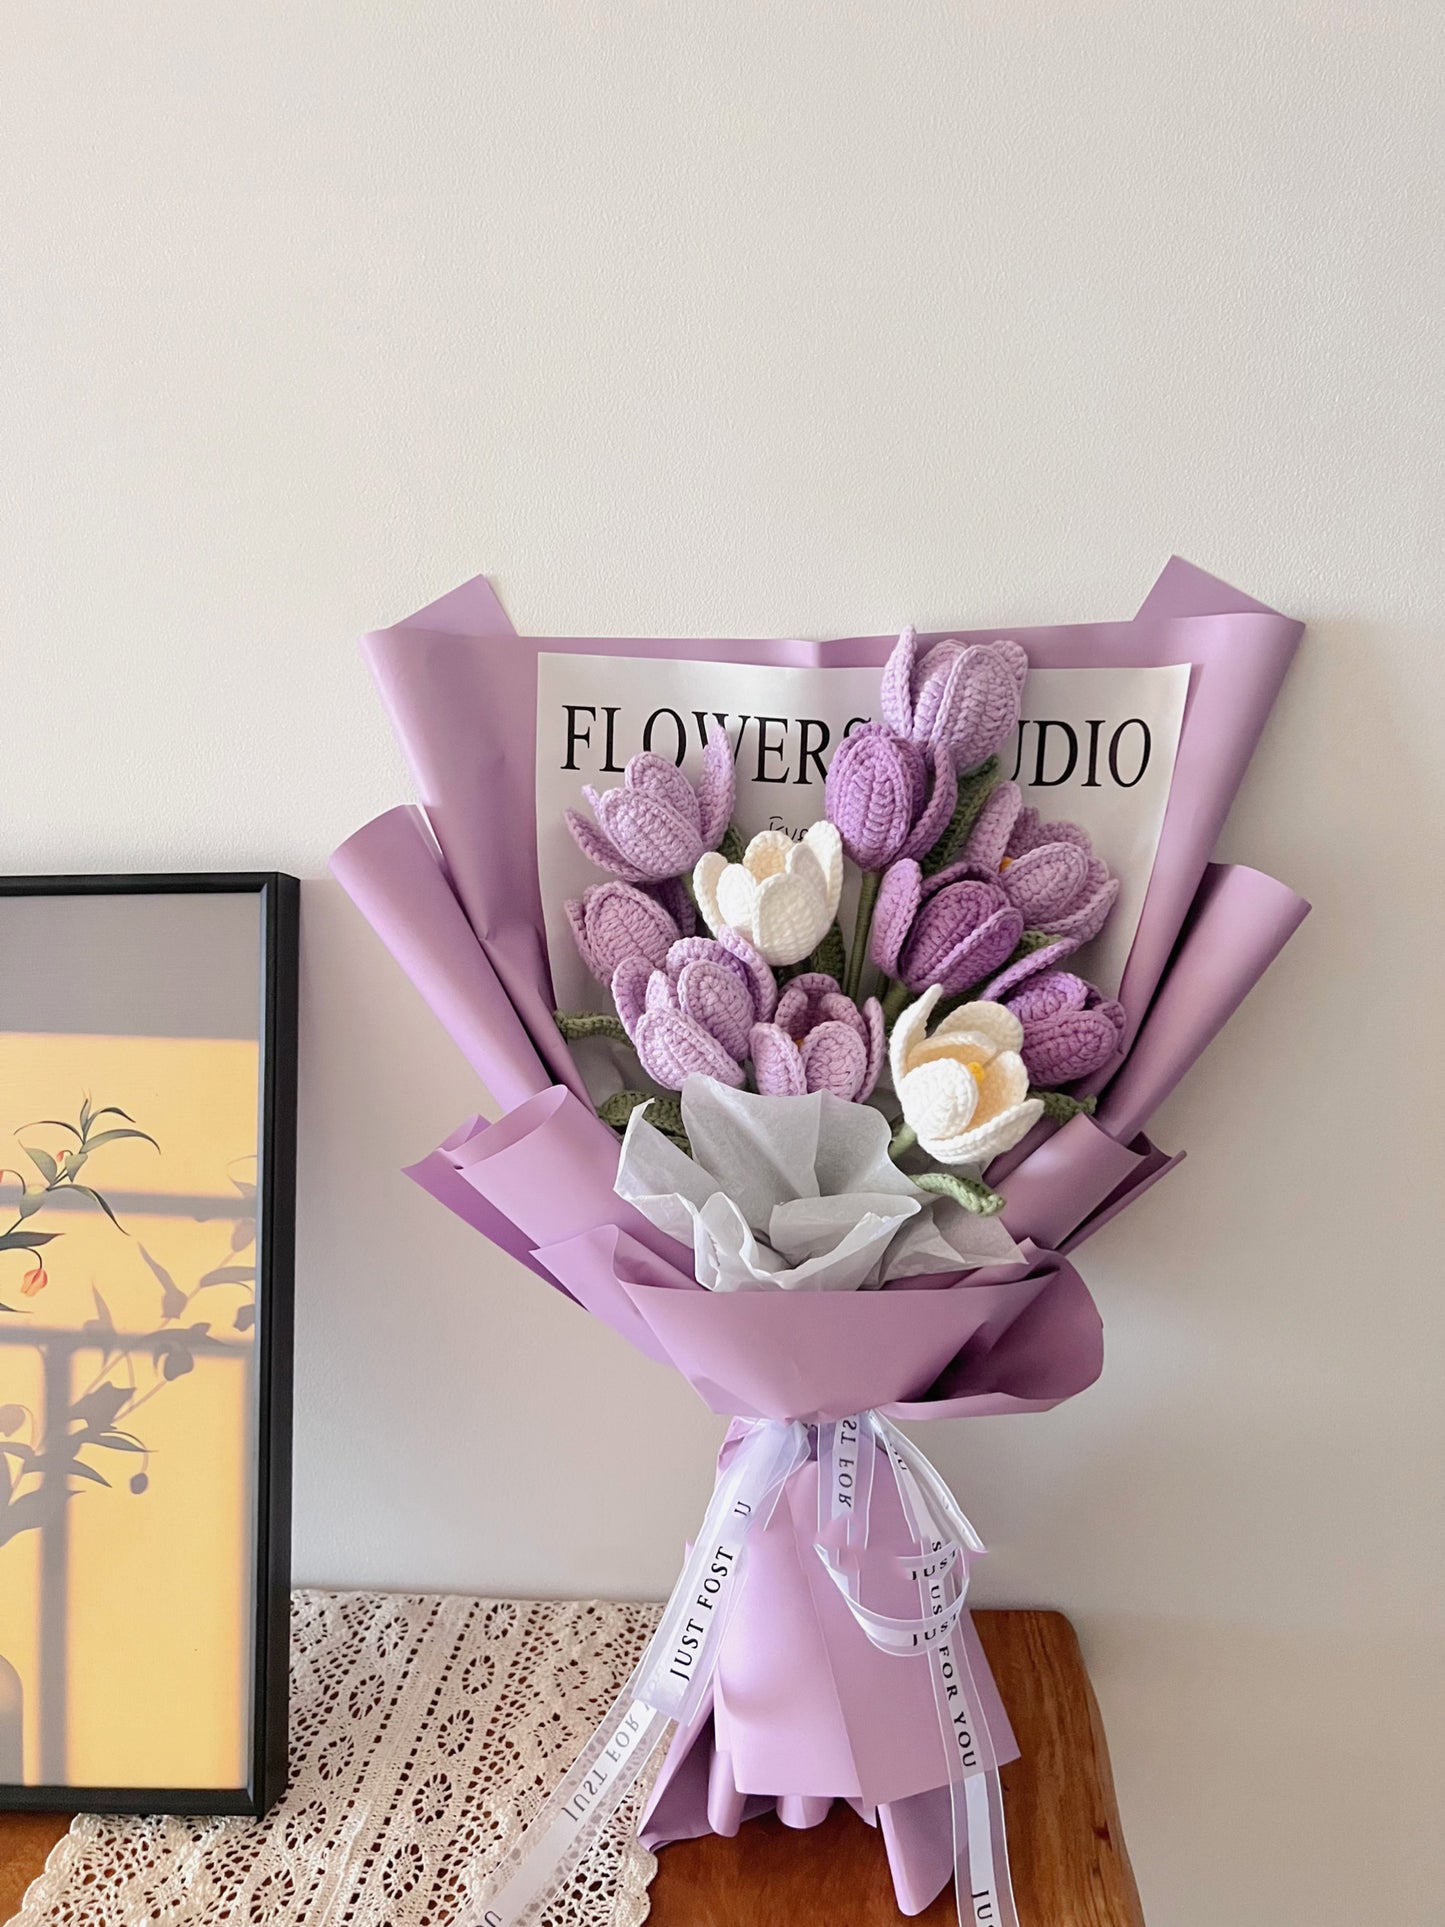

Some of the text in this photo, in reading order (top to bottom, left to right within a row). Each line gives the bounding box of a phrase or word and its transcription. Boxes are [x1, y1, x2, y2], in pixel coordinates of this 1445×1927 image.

[670, 1546, 733, 1681] JUST FOST
[939, 1646, 958, 1701] FOR
[953, 1711, 976, 1767] YOU
[971, 1890, 993, 1927] JU
